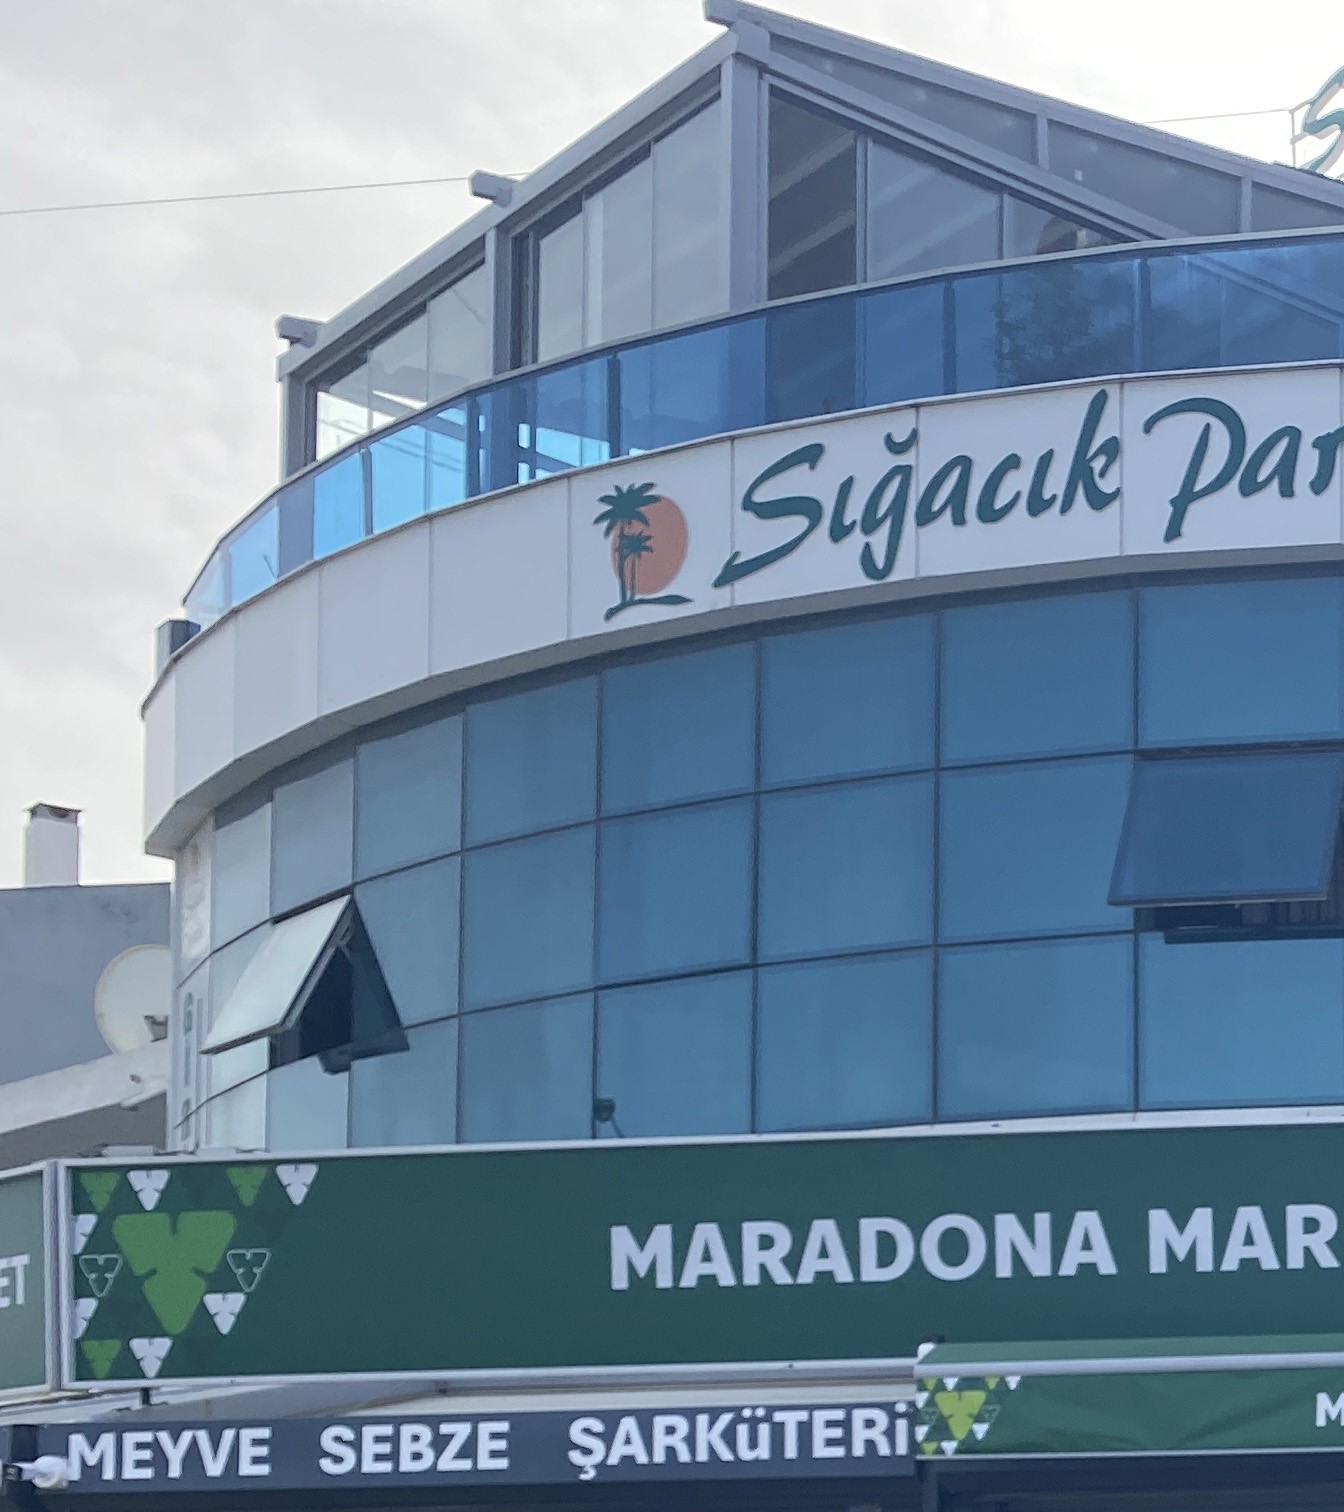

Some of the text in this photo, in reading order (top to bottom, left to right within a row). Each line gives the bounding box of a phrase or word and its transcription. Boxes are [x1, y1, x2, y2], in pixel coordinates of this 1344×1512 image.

[713, 389, 1121, 588] Sığacık
[610, 1210, 1118, 1292] MARADONA
[67, 1426, 273, 1482] MEYVE
[318, 1420, 512, 1476] SEBZE
